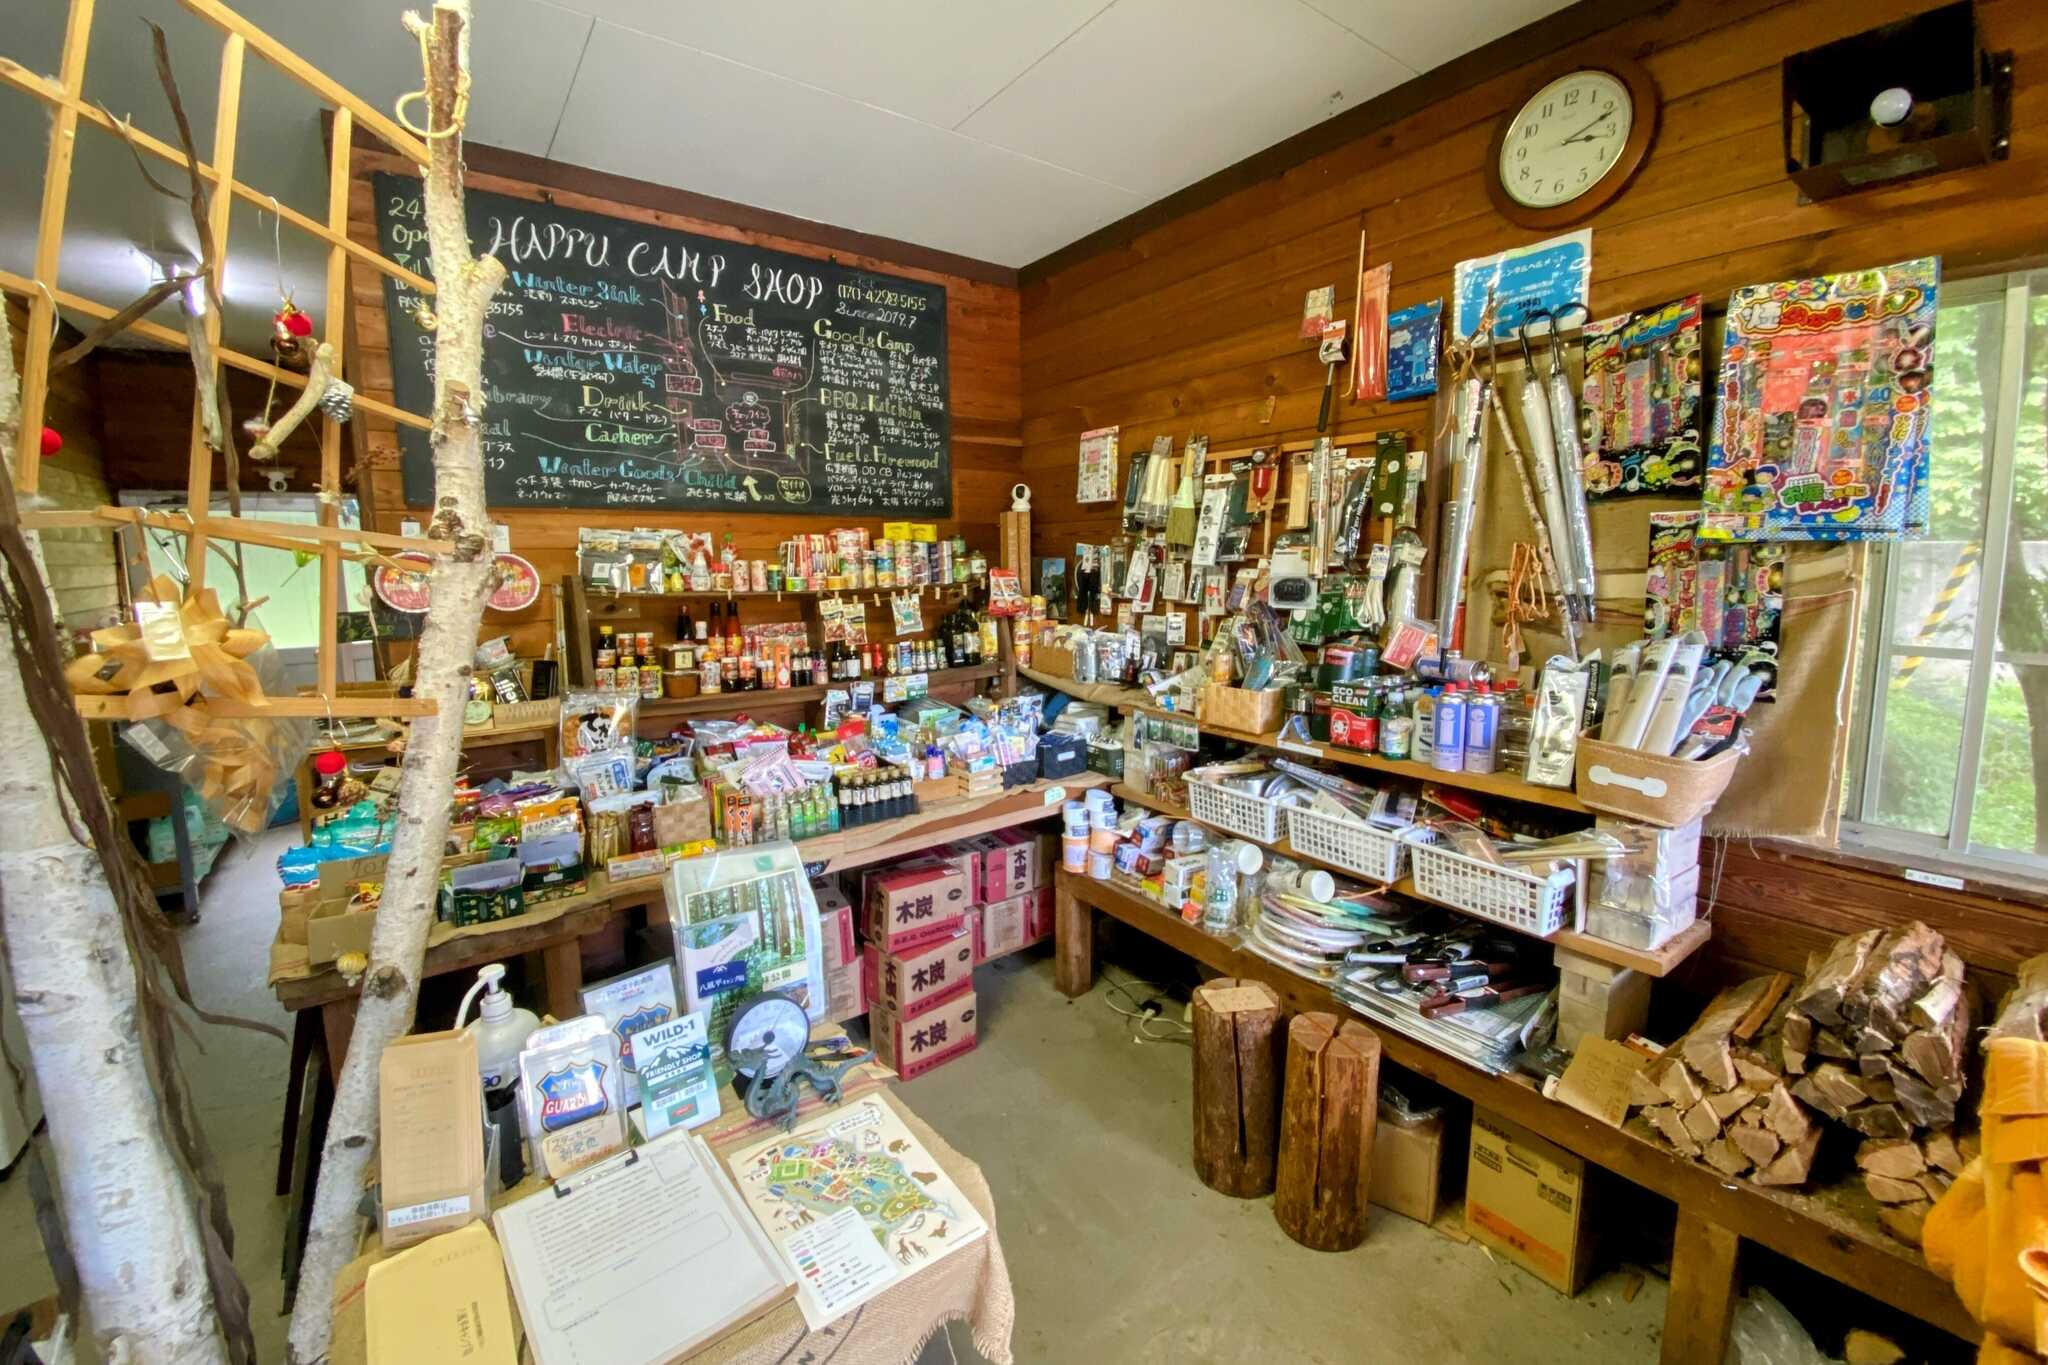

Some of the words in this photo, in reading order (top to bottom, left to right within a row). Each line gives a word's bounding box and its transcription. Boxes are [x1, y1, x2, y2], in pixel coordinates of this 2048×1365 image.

[1563, 88, 1580, 107] 12
[1590, 89, 1599, 104] 1
[1541, 103, 1554, 119] 11
[1524, 124, 1539, 139] 10
[1606, 122, 1617, 137] 3
[1517, 147, 1527, 161] 9
[1519, 167, 1530, 182] 8
[1576, 168, 1588, 184] 5
[1533, 179, 1544, 194] 7
[1553, 179, 1565, 193] 6
[627, 242, 725, 287] CAMP
[742, 263, 823, 309] SHOP
[596, 280, 644, 305] Sink
[713, 304, 755, 326] Food
[561, 313, 642, 341] Electric
[877, 330, 915, 355] Camp
[603, 352, 662, 375] Water
[582, 385, 651, 410] Drink
[820, 388, 858, 410] BBQ
[824, 443, 861, 461] Fuel
[873, 445, 939, 468] Firewood
[862, 466, 876, 475] OD
[879, 467, 893, 477] CB
[495, 679, 519, 704] eiji
[1332, 687, 1353, 695] ECO
[1332, 695, 1368, 707] CLEAN
[1013, 848, 1027, 881] 木炭
[896, 894, 934, 925] 木炭
[911, 958, 946, 993] 木炭
[643, 1019, 695, 1047] WILD-1
[910, 1019, 948, 1053] 木炭
[646, 1060, 681, 1080] FRIENDLY
[682, 1051, 703, 1064] SHOP
